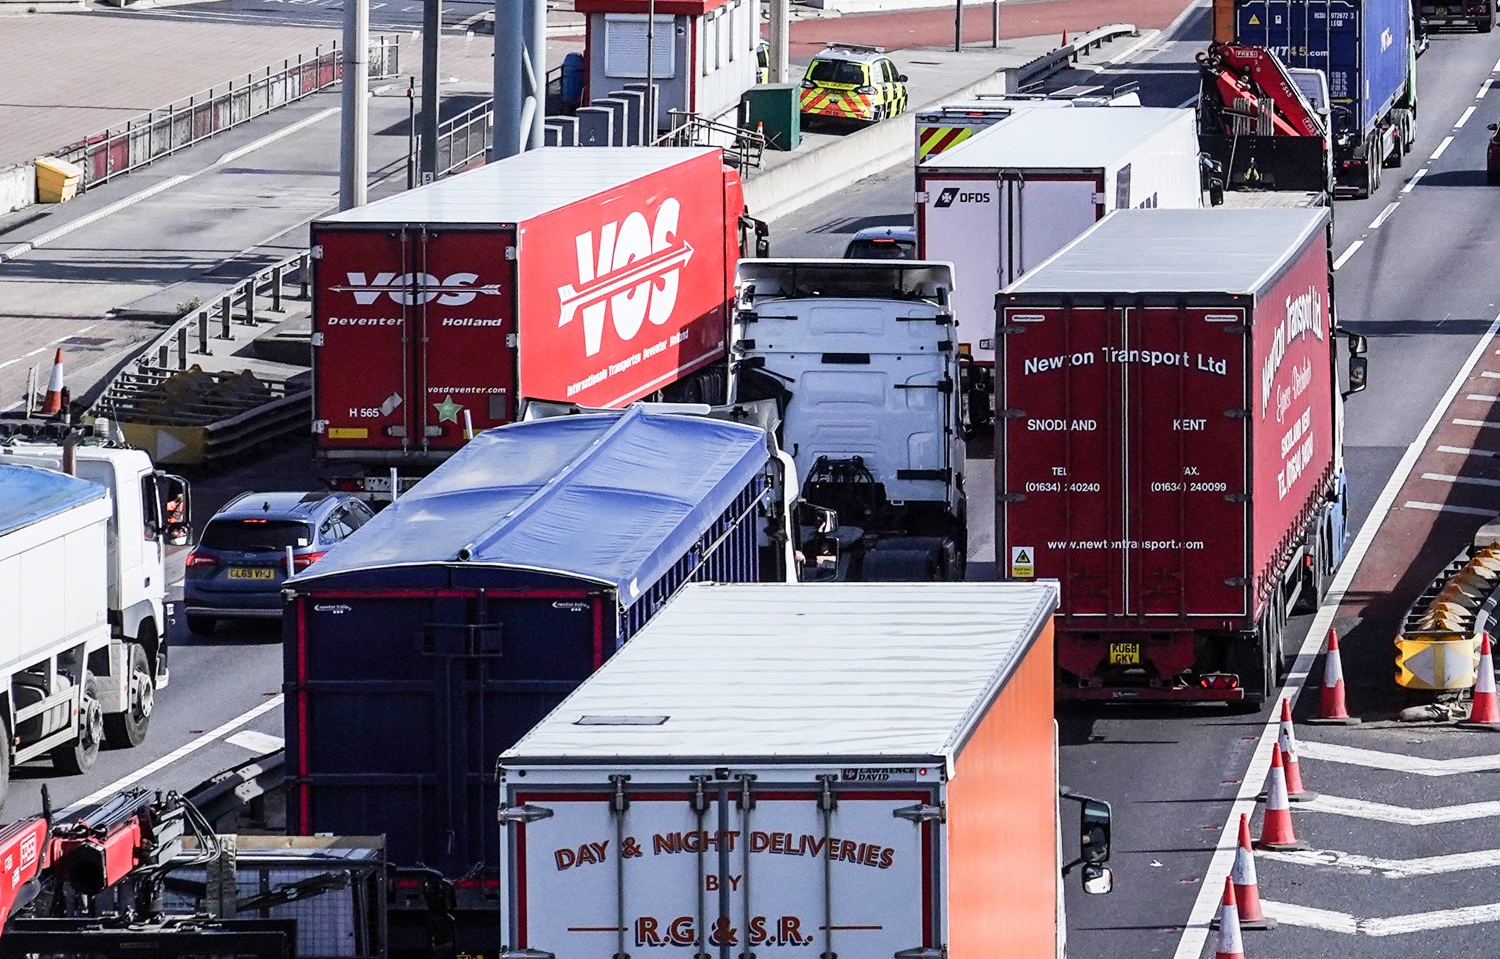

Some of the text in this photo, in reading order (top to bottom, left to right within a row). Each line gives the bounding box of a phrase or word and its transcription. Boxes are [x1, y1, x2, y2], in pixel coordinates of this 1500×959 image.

[959, 192, 991, 203] DFDS
[575, 197, 681, 358] VOS
[346, 271, 479, 306] VOS
[327, 317, 502, 327] Deventer Holland
[643, 340, 668, 361] Deventer
[1024, 346, 1227, 375] Newon Transport Ltd
[427, 385, 506, 395] vosdeventer.com
[349, 409, 379, 418] H 565
[1027, 419, 1207, 431] SNODLAND KENT
[1183, 467, 1200, 476] AX.
[1026, 482, 1061, 492] (01634)
[1190, 482, 1226, 491] 240099
[1112, 644, 1137, 653] KU68
[858, 773, 890, 781] DAVID
[555, 829, 895, 871] DAY & NIGHT DELIVERIES
[706, 875, 742, 892] BY
[708, 915, 738, 947] &
[749, 916, 814, 947] S.R.
